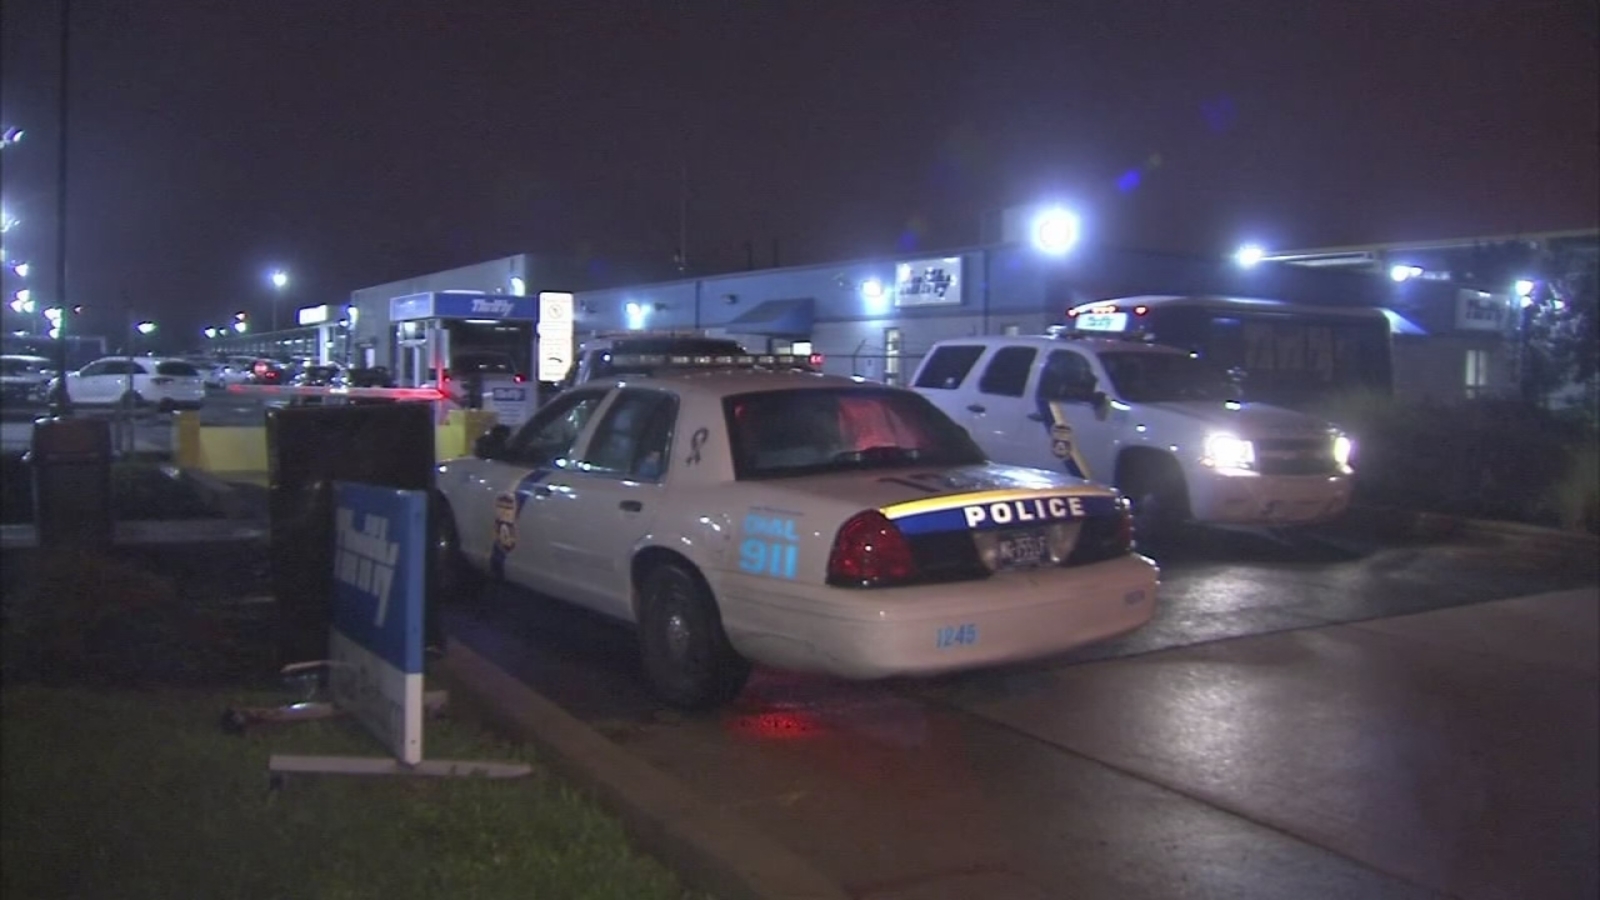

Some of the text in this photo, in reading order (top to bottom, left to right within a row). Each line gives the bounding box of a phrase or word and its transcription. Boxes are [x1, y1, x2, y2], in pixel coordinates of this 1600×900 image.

[743, 513, 800, 541] DIAL
[963, 496, 1085, 528] POLICE
[739, 537, 799, 580] 911
[935, 622, 978, 649] 1245
